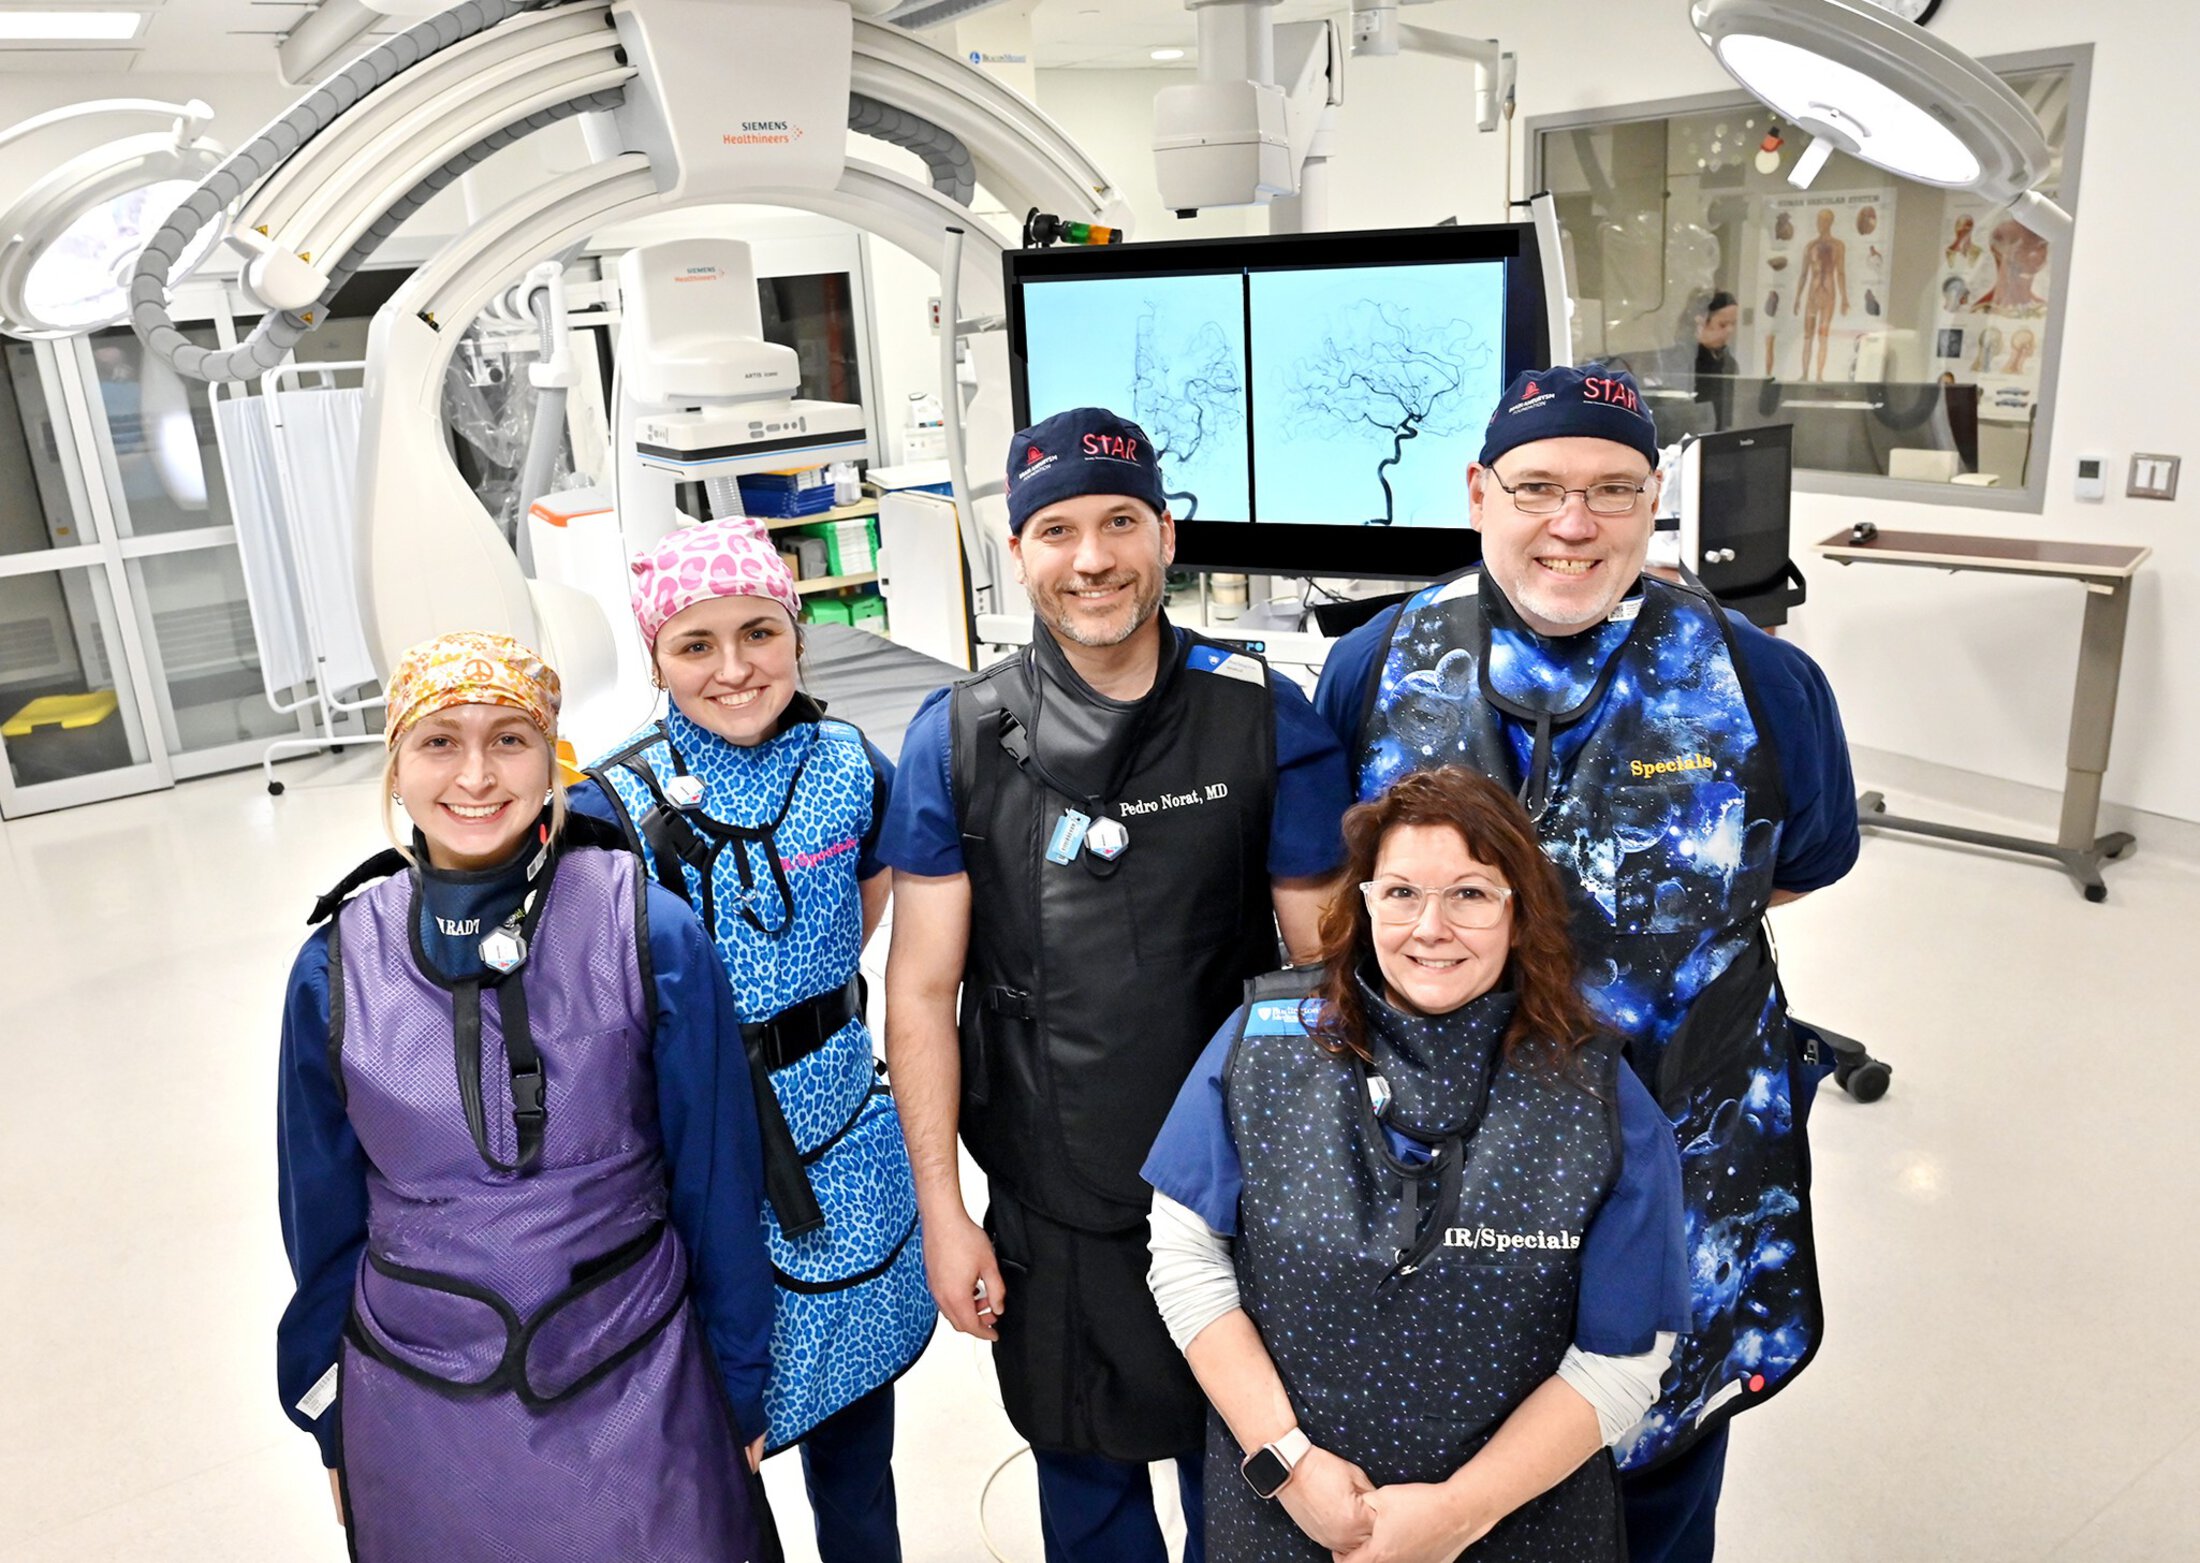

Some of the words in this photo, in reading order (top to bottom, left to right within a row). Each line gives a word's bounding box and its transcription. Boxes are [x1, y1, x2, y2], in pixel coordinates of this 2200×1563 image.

[741, 120, 788, 131] SIEMENS
[723, 134, 789, 145] Healthineers
[1583, 377, 1637, 412] STAR
[1083, 433, 1138, 462] STAR
[1630, 753, 1713, 777] Specials
[1119, 799, 1159, 817] Pedro
[1160, 793, 1204, 810] Norat,
[1204, 782, 1229, 801] MD
[1443, 1227, 1581, 1252] IR/Specials
